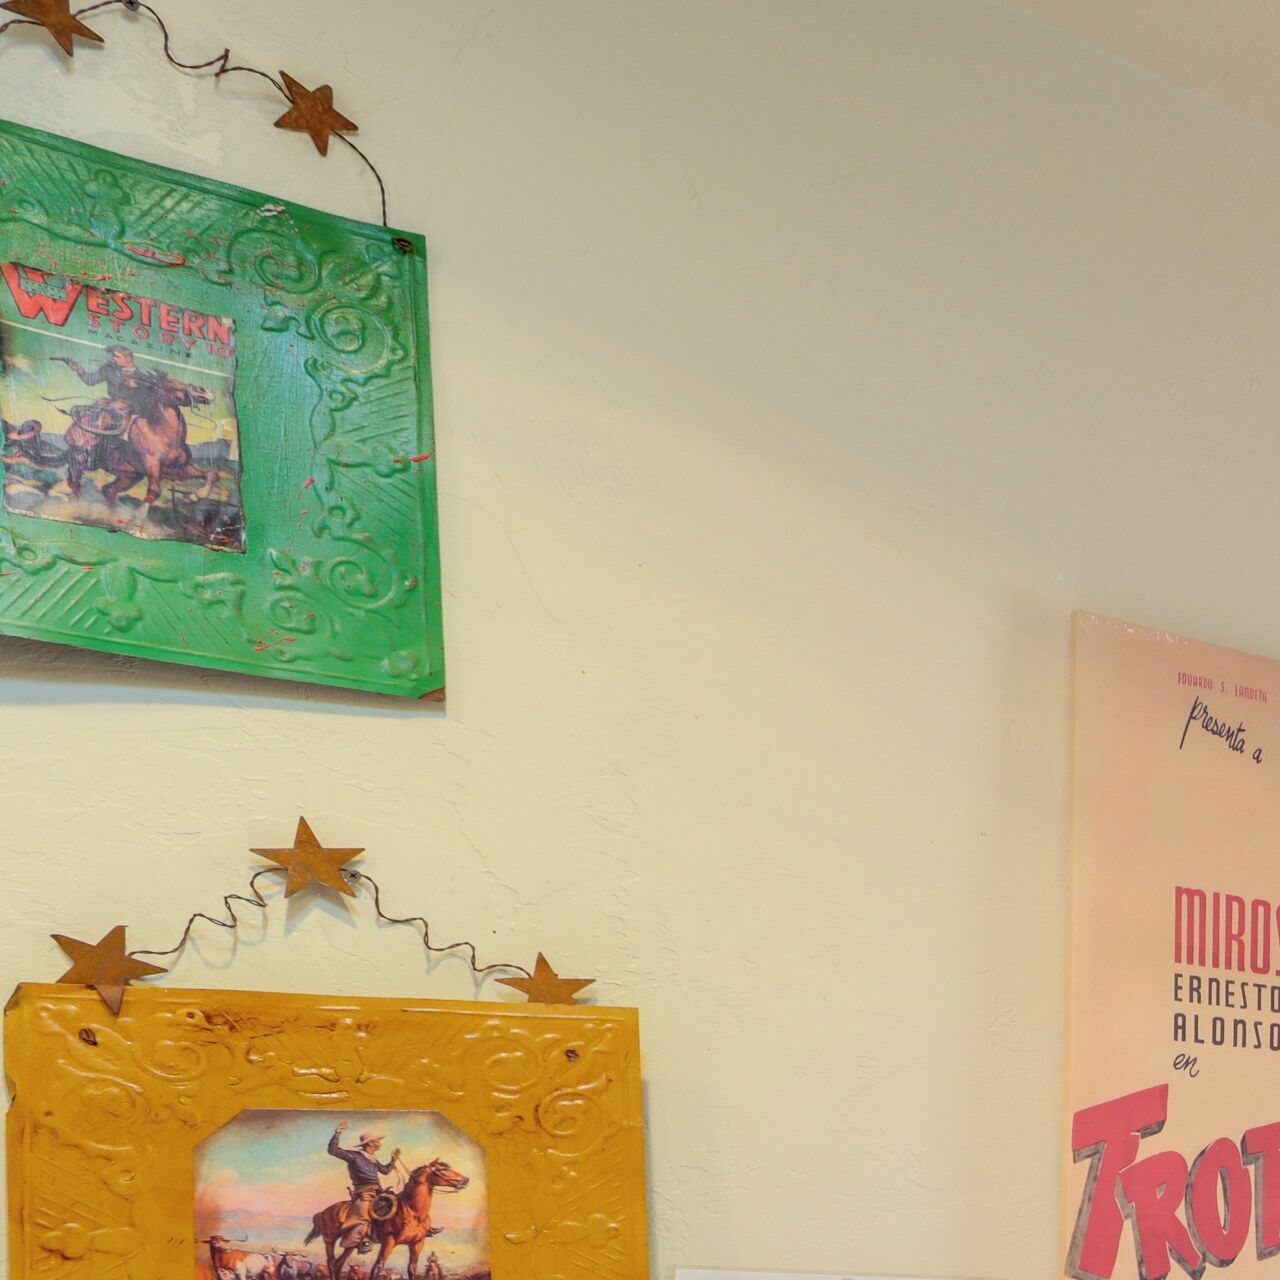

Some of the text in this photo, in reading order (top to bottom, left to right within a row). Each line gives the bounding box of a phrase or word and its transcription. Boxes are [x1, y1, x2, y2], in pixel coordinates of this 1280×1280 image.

[1, 261, 231, 344] WESTERN
[86, 313, 196, 350] STORY
[1178, 672, 1213, 690] EDUARDO
[1235, 685, 1267, 703] LANDETA
[1179, 696, 1262, 764] presenta a
[1172, 1053, 1200, 1077] en
